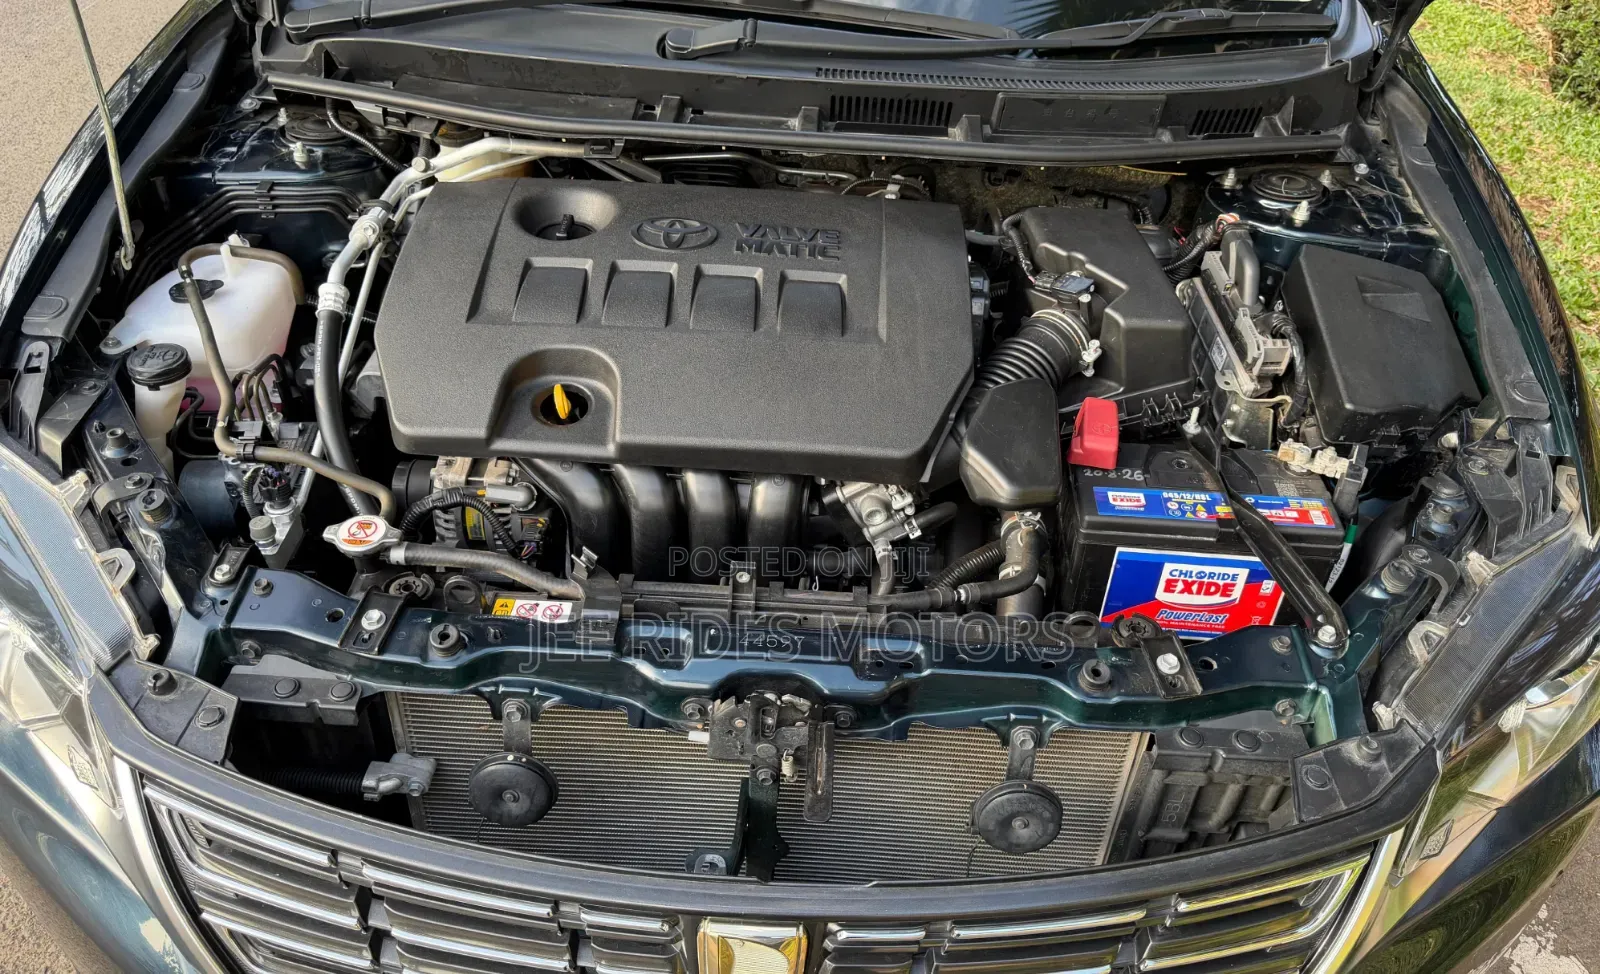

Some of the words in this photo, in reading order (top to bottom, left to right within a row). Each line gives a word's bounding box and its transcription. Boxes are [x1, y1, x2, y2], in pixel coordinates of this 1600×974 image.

[736, 222, 840, 244] VALVE
[735, 239, 840, 260] MATIC
[1169, 569, 1239, 582] CHLORIDE
[1163, 578, 1238, 598] EXIDE
